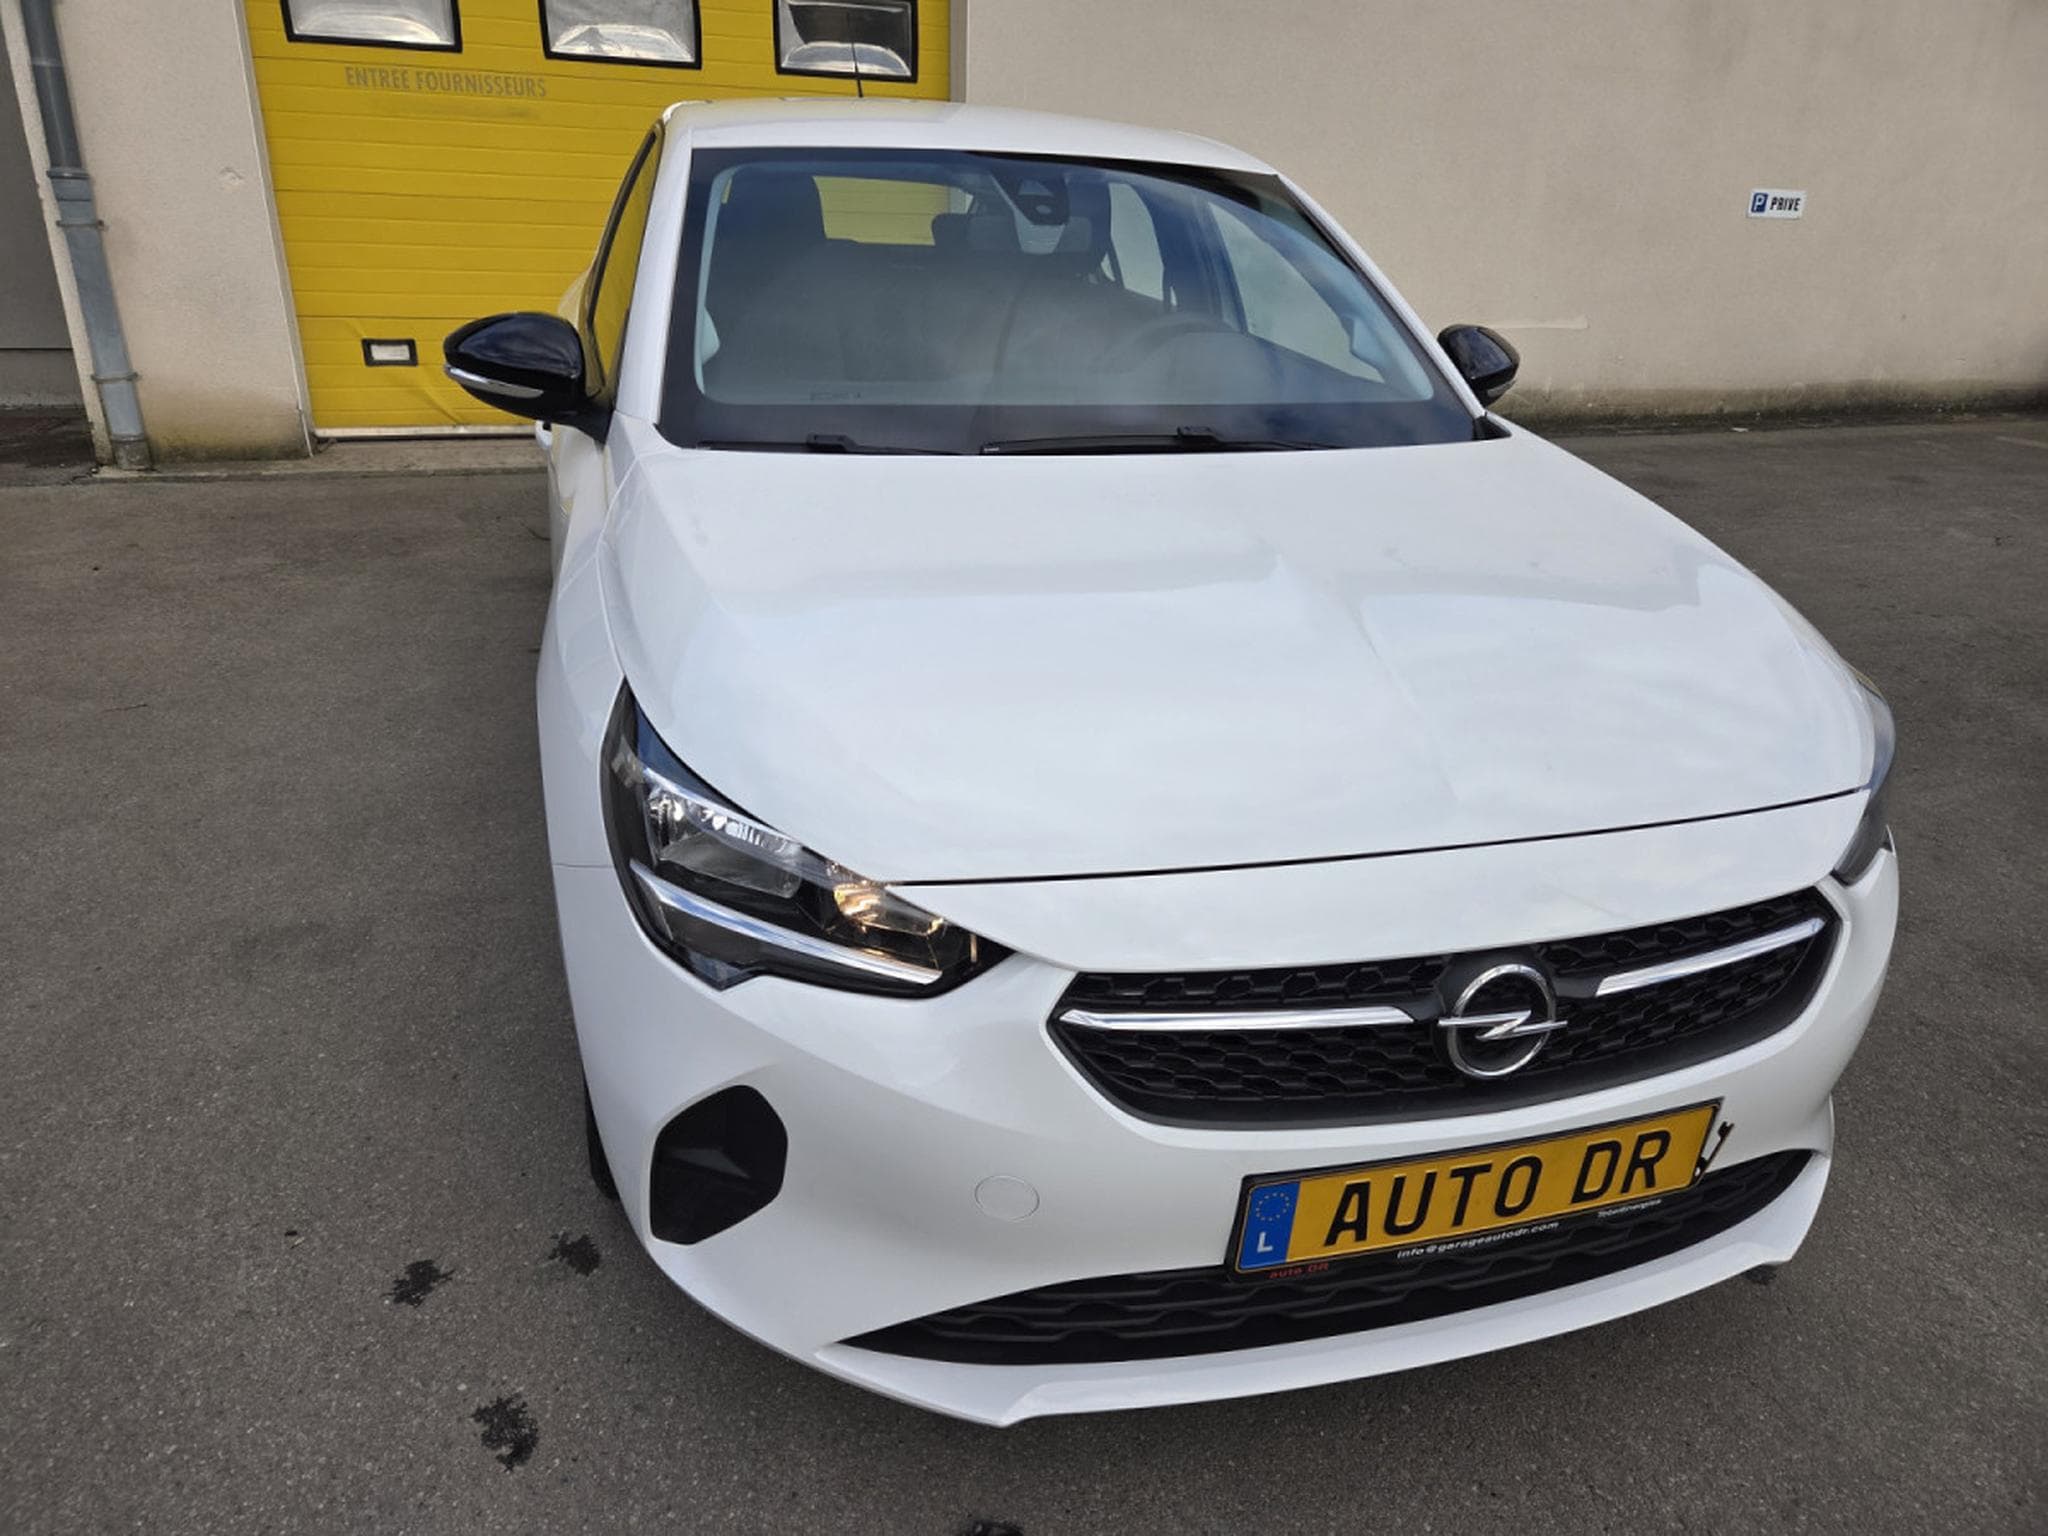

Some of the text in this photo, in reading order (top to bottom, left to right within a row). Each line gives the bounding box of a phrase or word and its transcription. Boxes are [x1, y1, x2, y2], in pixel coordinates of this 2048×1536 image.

[415, 71, 547, 98] FOURNISSEURS
[1324, 1130, 1671, 1247] AUTO DR
[1257, 1231, 1274, 1254] L
